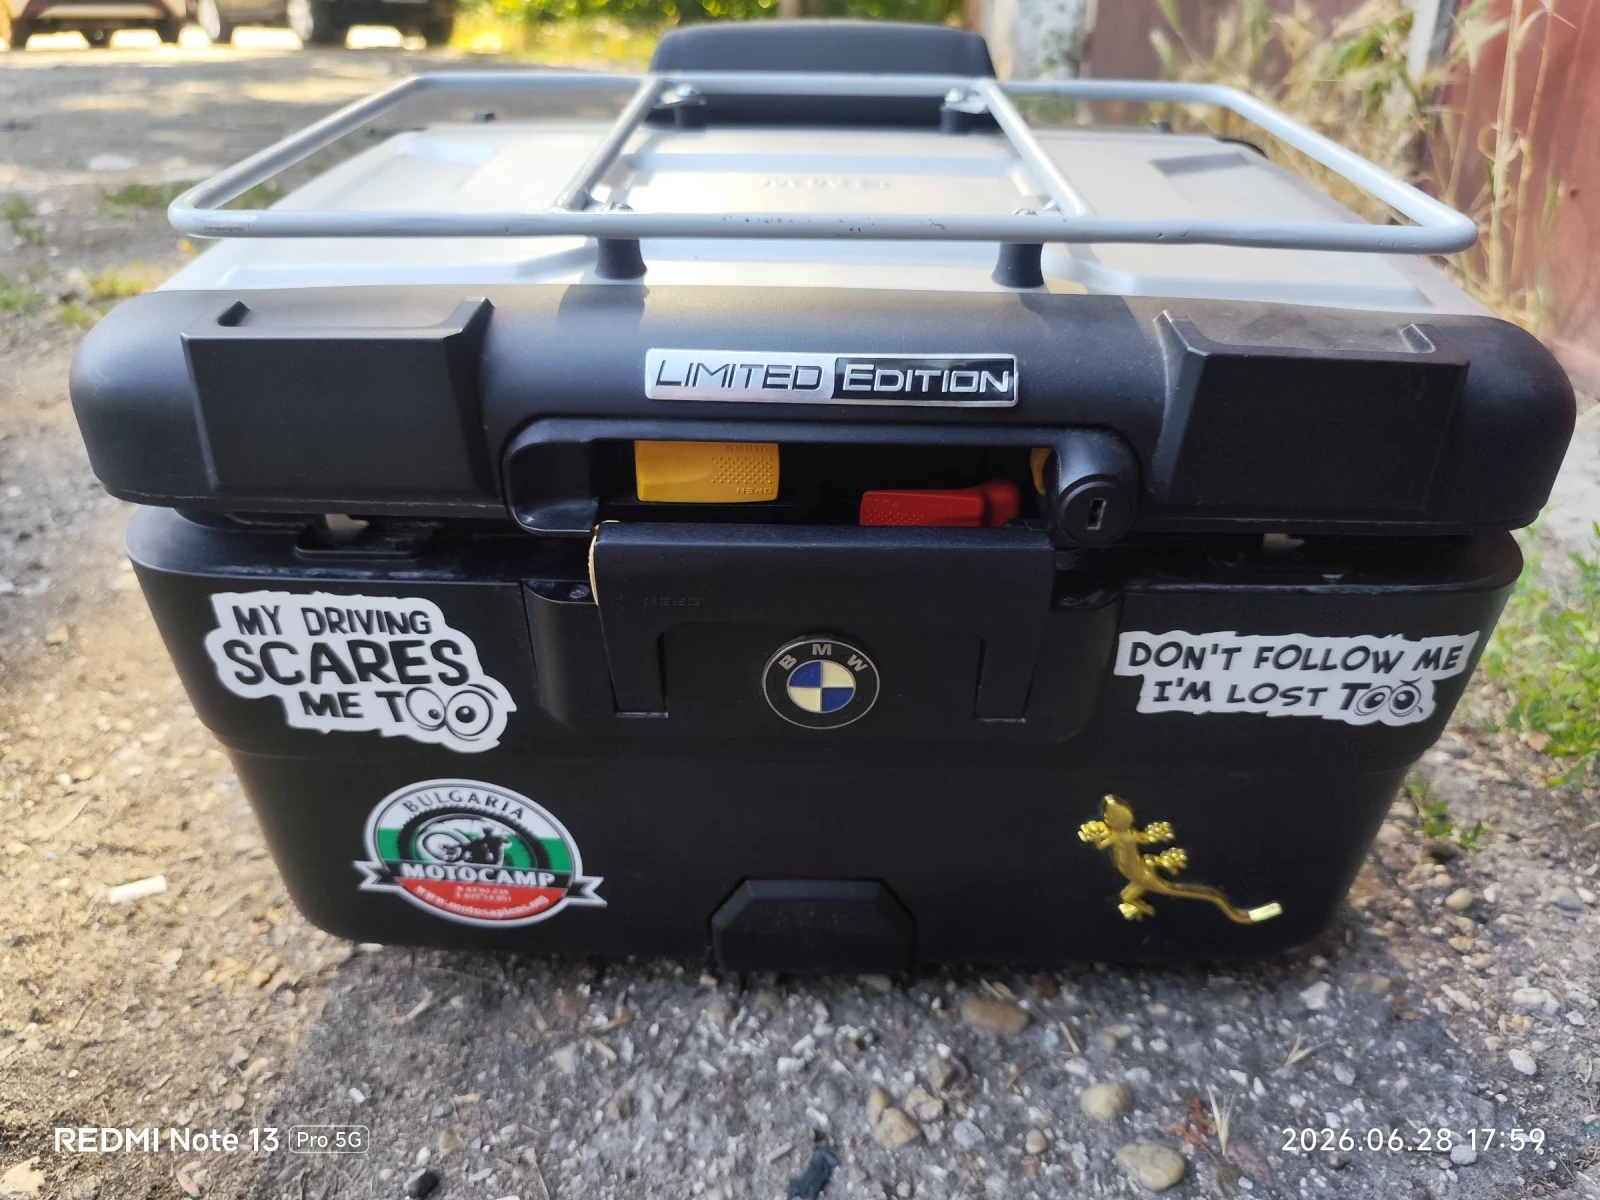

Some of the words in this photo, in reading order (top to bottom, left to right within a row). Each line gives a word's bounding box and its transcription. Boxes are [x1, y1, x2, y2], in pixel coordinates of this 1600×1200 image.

[655, 360, 823, 391] LIMITED
[842, 364, 1010, 394] EDITION
[232, 604, 281, 636] MY
[301, 606, 433, 636] DRIVING
[223, 639, 470, 686] SCARES
[778, 643, 868, 672] BMW
[1128, 642, 1242, 671] DON'T
[1253, 644, 1404, 674] FOLLOW
[1412, 645, 1465, 671] ME
[299, 690, 365, 719] ME
[1152, 677, 1211, 703] I'M
[1226, 682, 1328, 707] LOST
[401, 790, 524, 819] BULGARIA
[401, 862, 556, 887] MOTOCAMP
